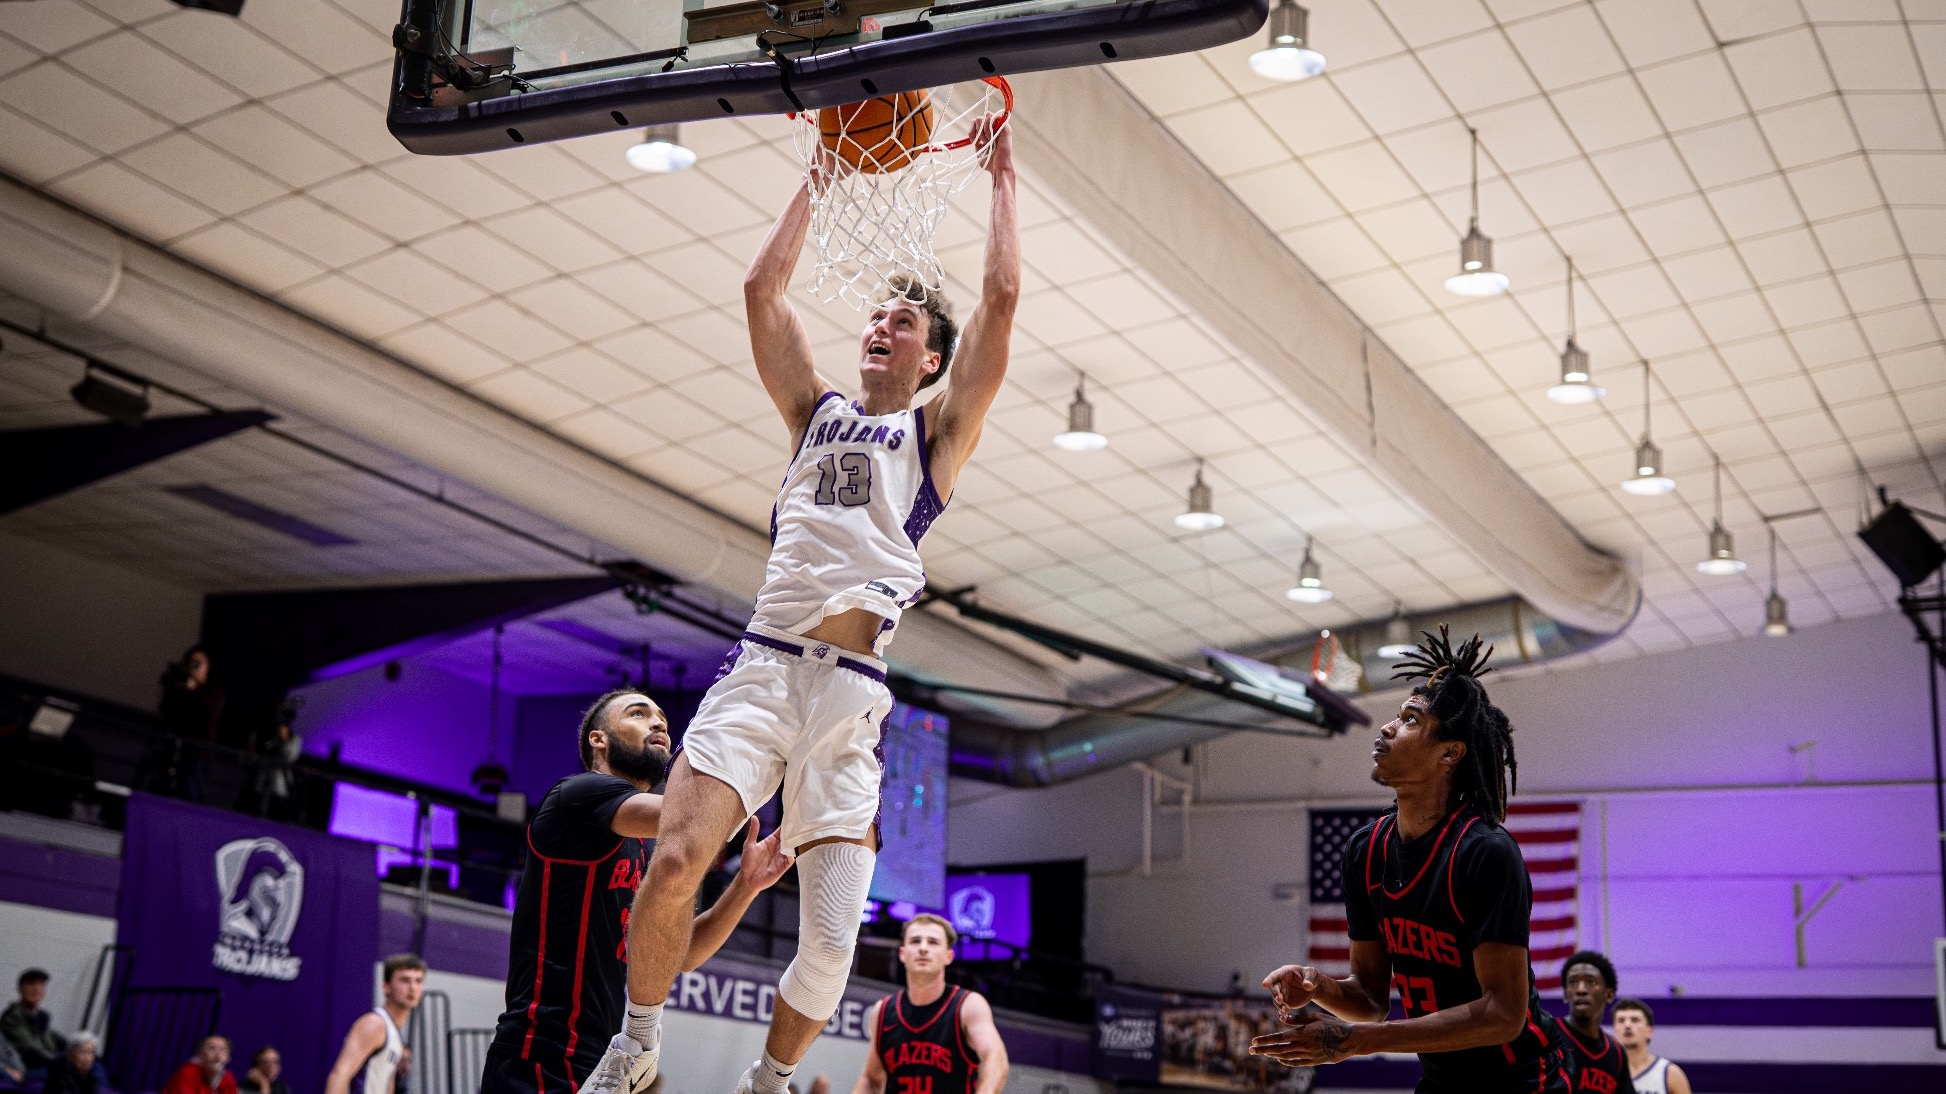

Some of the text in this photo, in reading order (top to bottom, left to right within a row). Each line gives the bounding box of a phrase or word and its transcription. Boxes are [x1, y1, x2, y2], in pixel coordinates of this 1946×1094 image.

[815, 453, 872, 506] 13
[212, 942, 302, 980] TROJANS
[1379, 917, 1461, 968] AZERS
[1578, 1067, 1617, 1094] AZER
